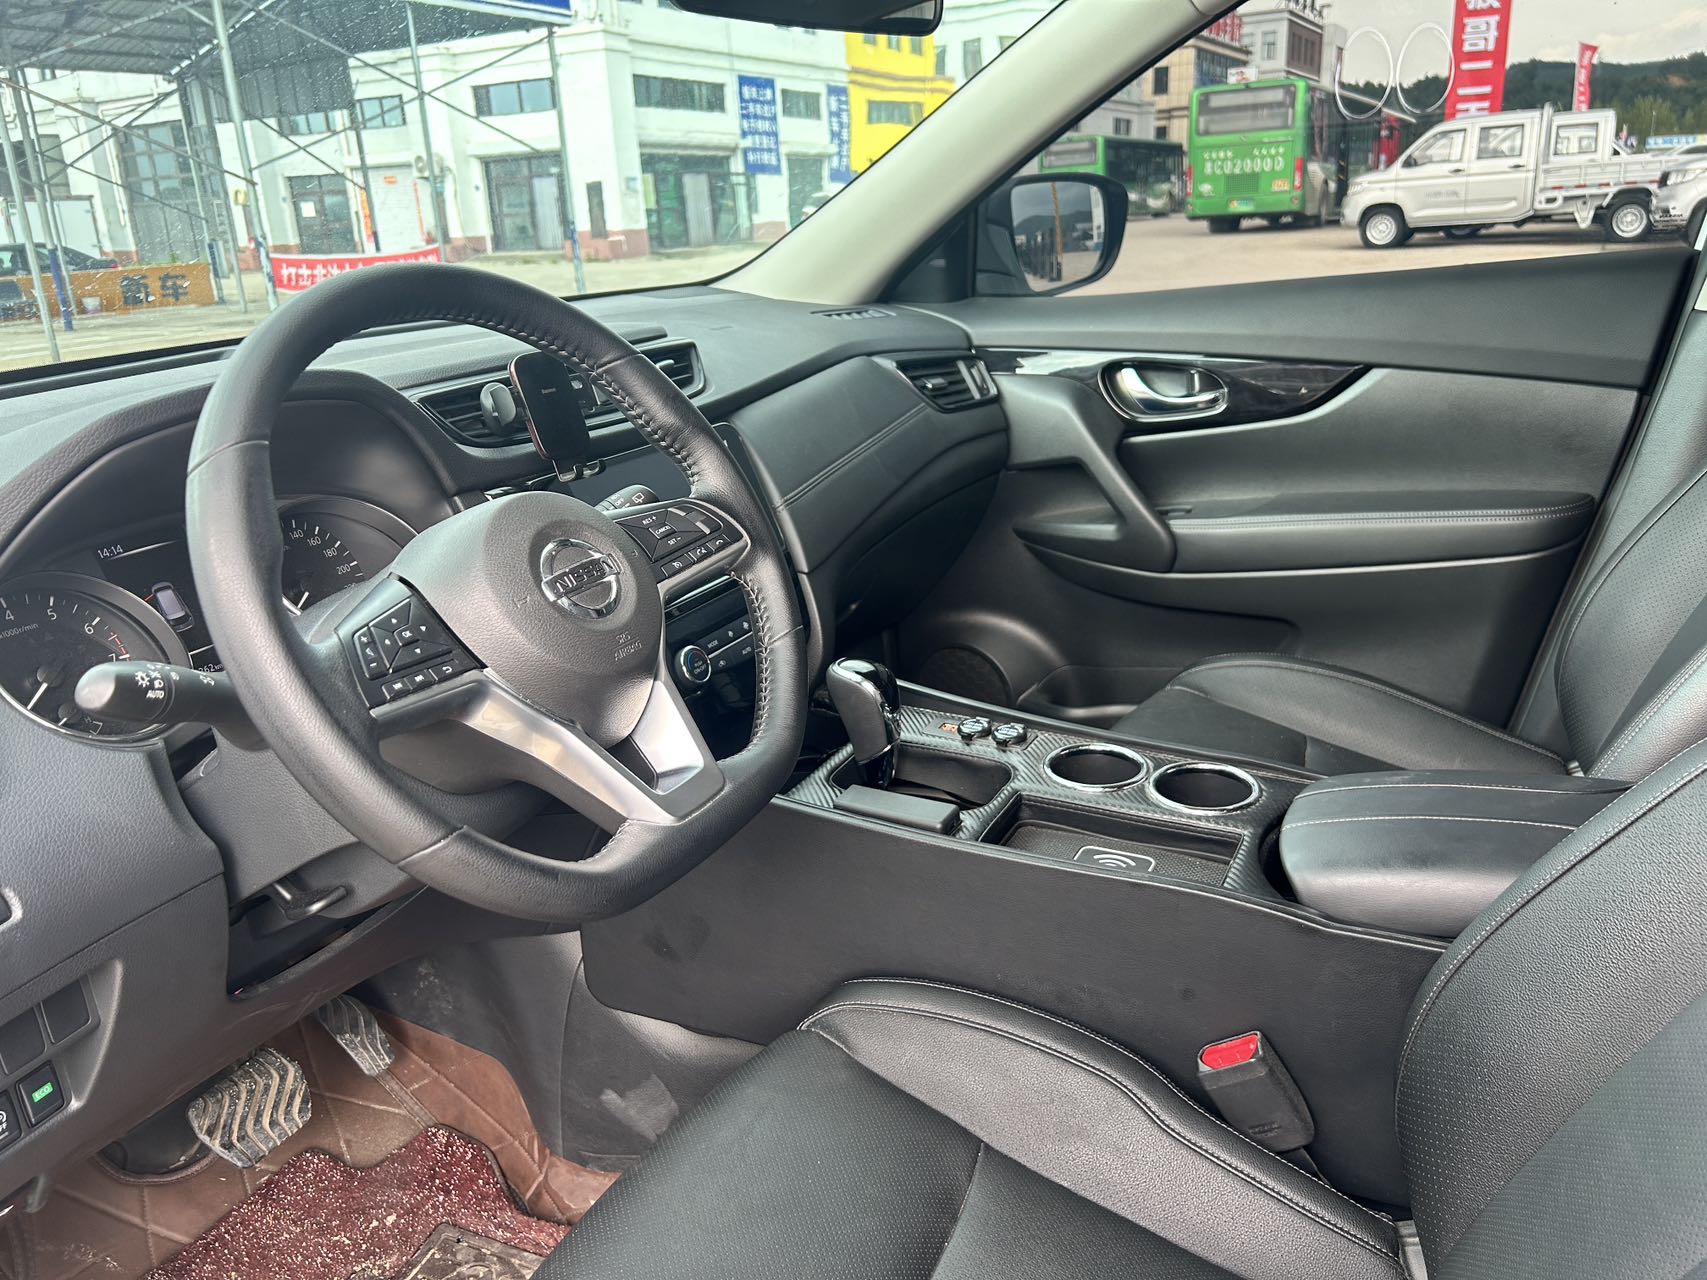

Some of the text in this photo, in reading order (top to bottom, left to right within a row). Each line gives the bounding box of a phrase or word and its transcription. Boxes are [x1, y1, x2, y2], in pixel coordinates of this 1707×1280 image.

[289, 529, 304, 540] 140
[307, 536, 321, 547] 160
[97, 545, 123, 559] 14:14
[323, 547, 338, 558] 180
[336, 564, 351, 575] 200
[555, 558, 615, 593] NISSAN
[5, 609, 15, 621] 4
[47, 608, 57, 620] 5
[84, 622, 94, 635] 6
[146, 690, 165, 700] AUTO
